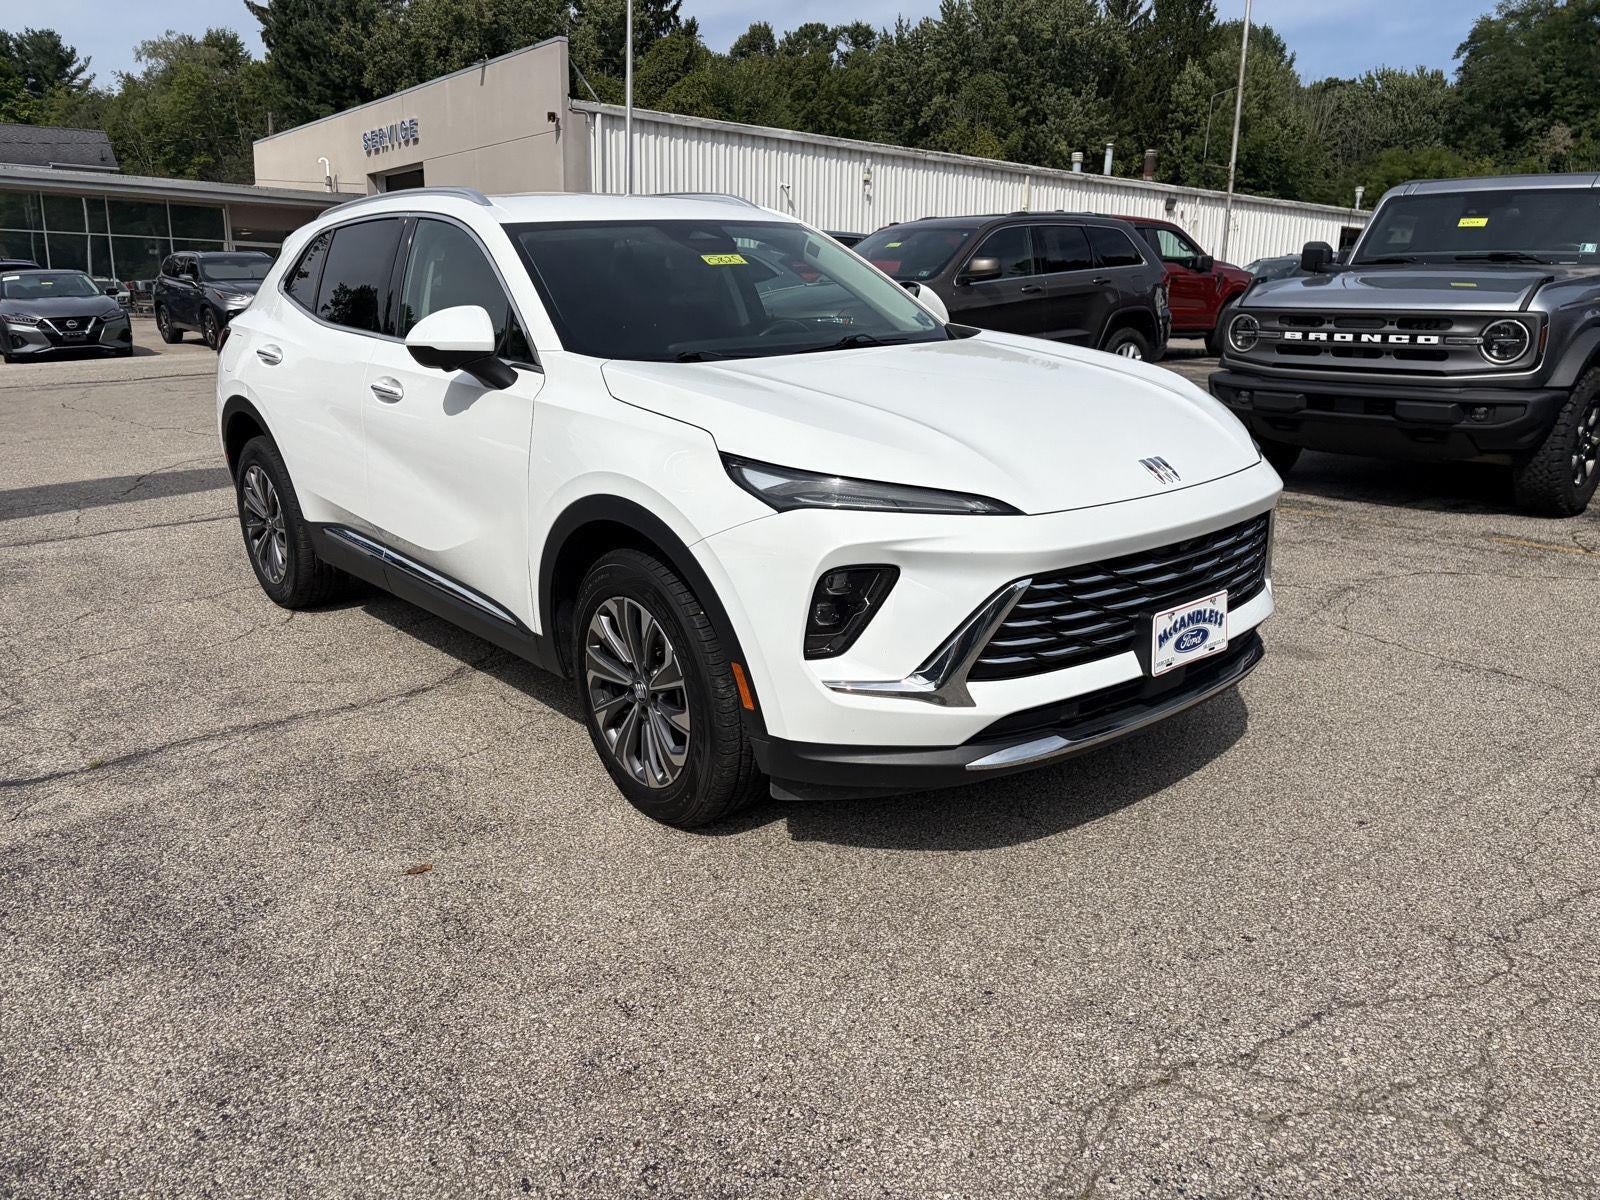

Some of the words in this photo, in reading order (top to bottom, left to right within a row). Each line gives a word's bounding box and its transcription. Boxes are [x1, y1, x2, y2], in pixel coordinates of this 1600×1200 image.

[363, 118, 418, 150] SERVICE
[1284, 331, 1439, 344] BRONCO
[1180, 630, 1203, 649] Ford
